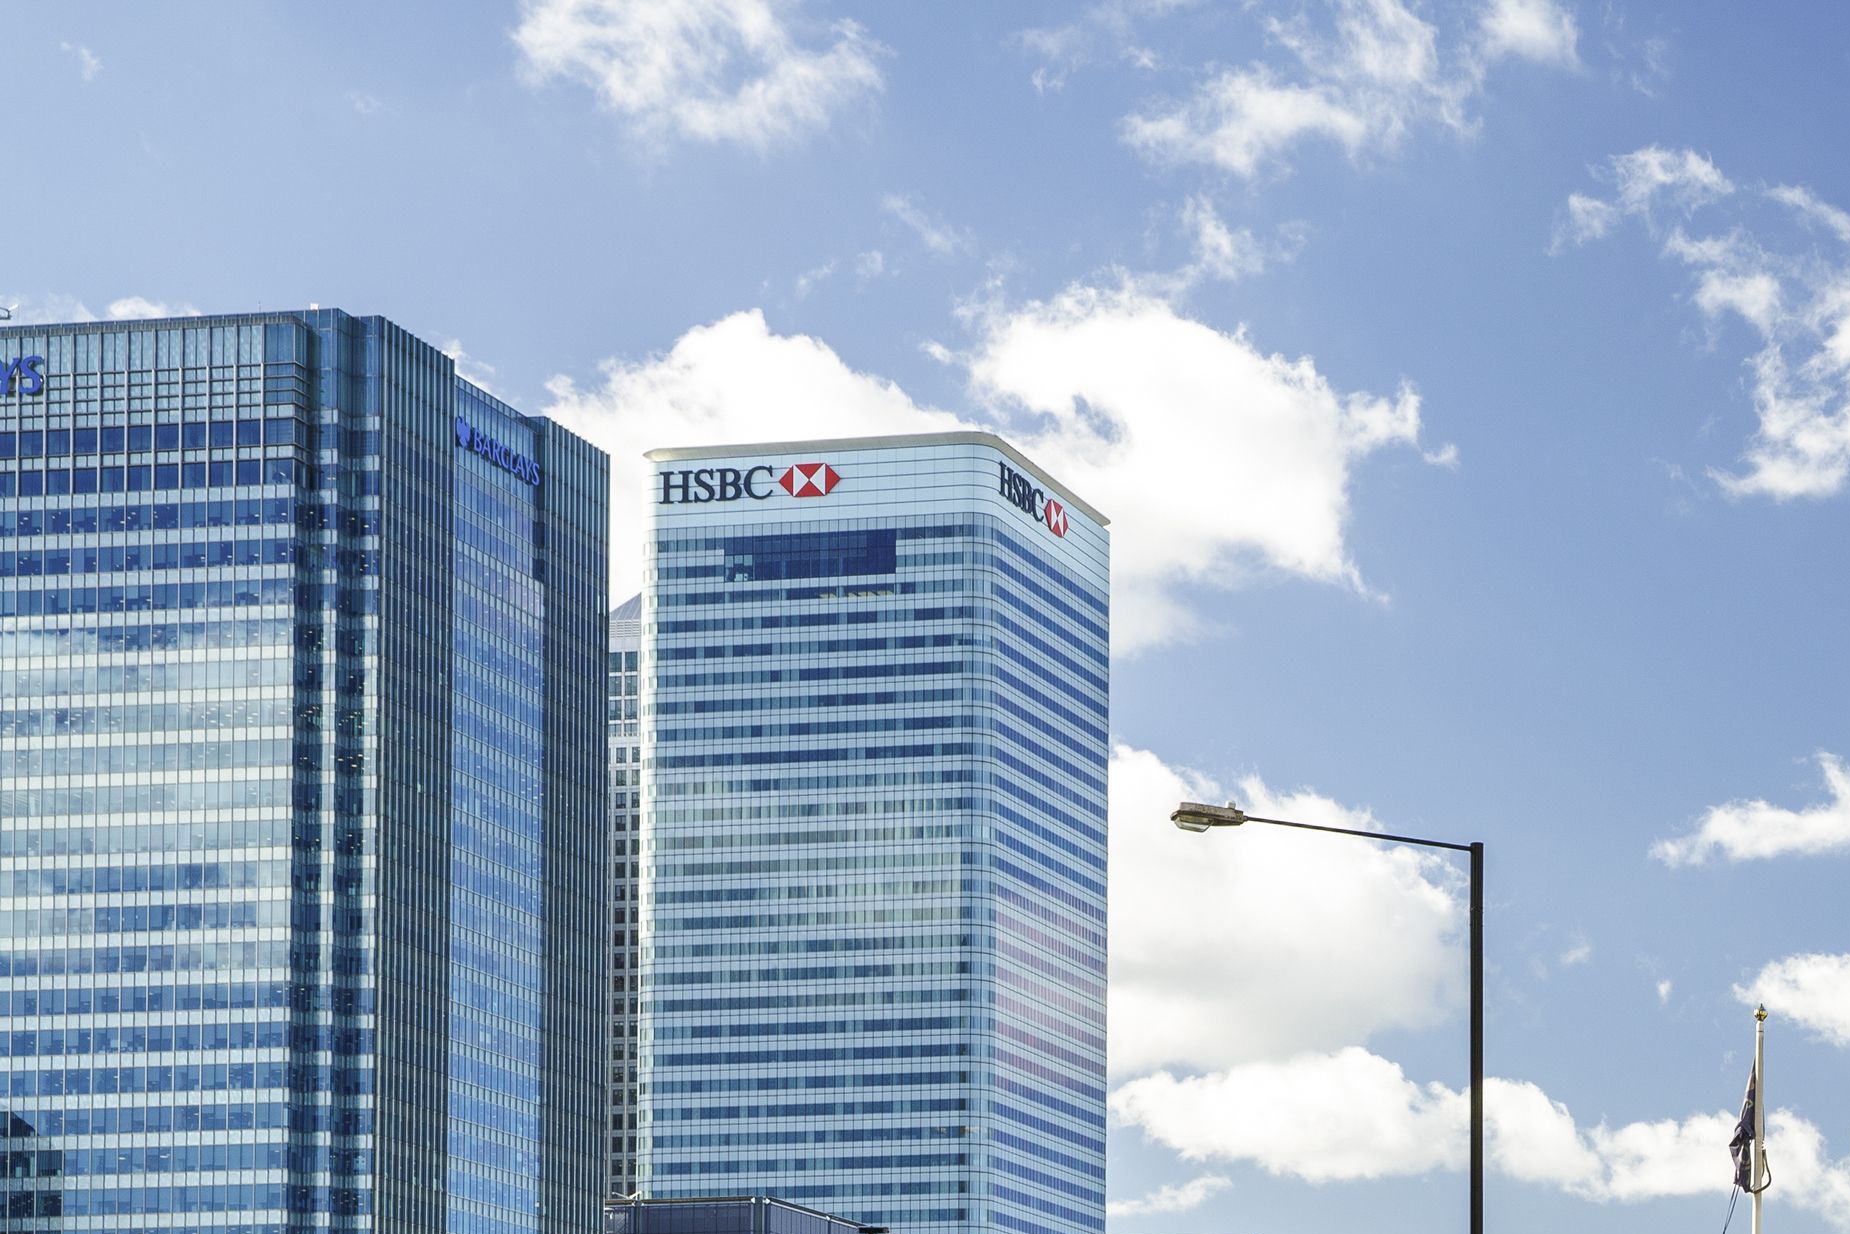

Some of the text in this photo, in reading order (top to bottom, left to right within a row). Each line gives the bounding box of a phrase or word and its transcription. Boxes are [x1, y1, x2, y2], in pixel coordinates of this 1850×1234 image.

[473, 427, 540, 487] BARCLAYS
[658, 464, 774, 505] HSBC
[999, 460, 1044, 523] HSBC
